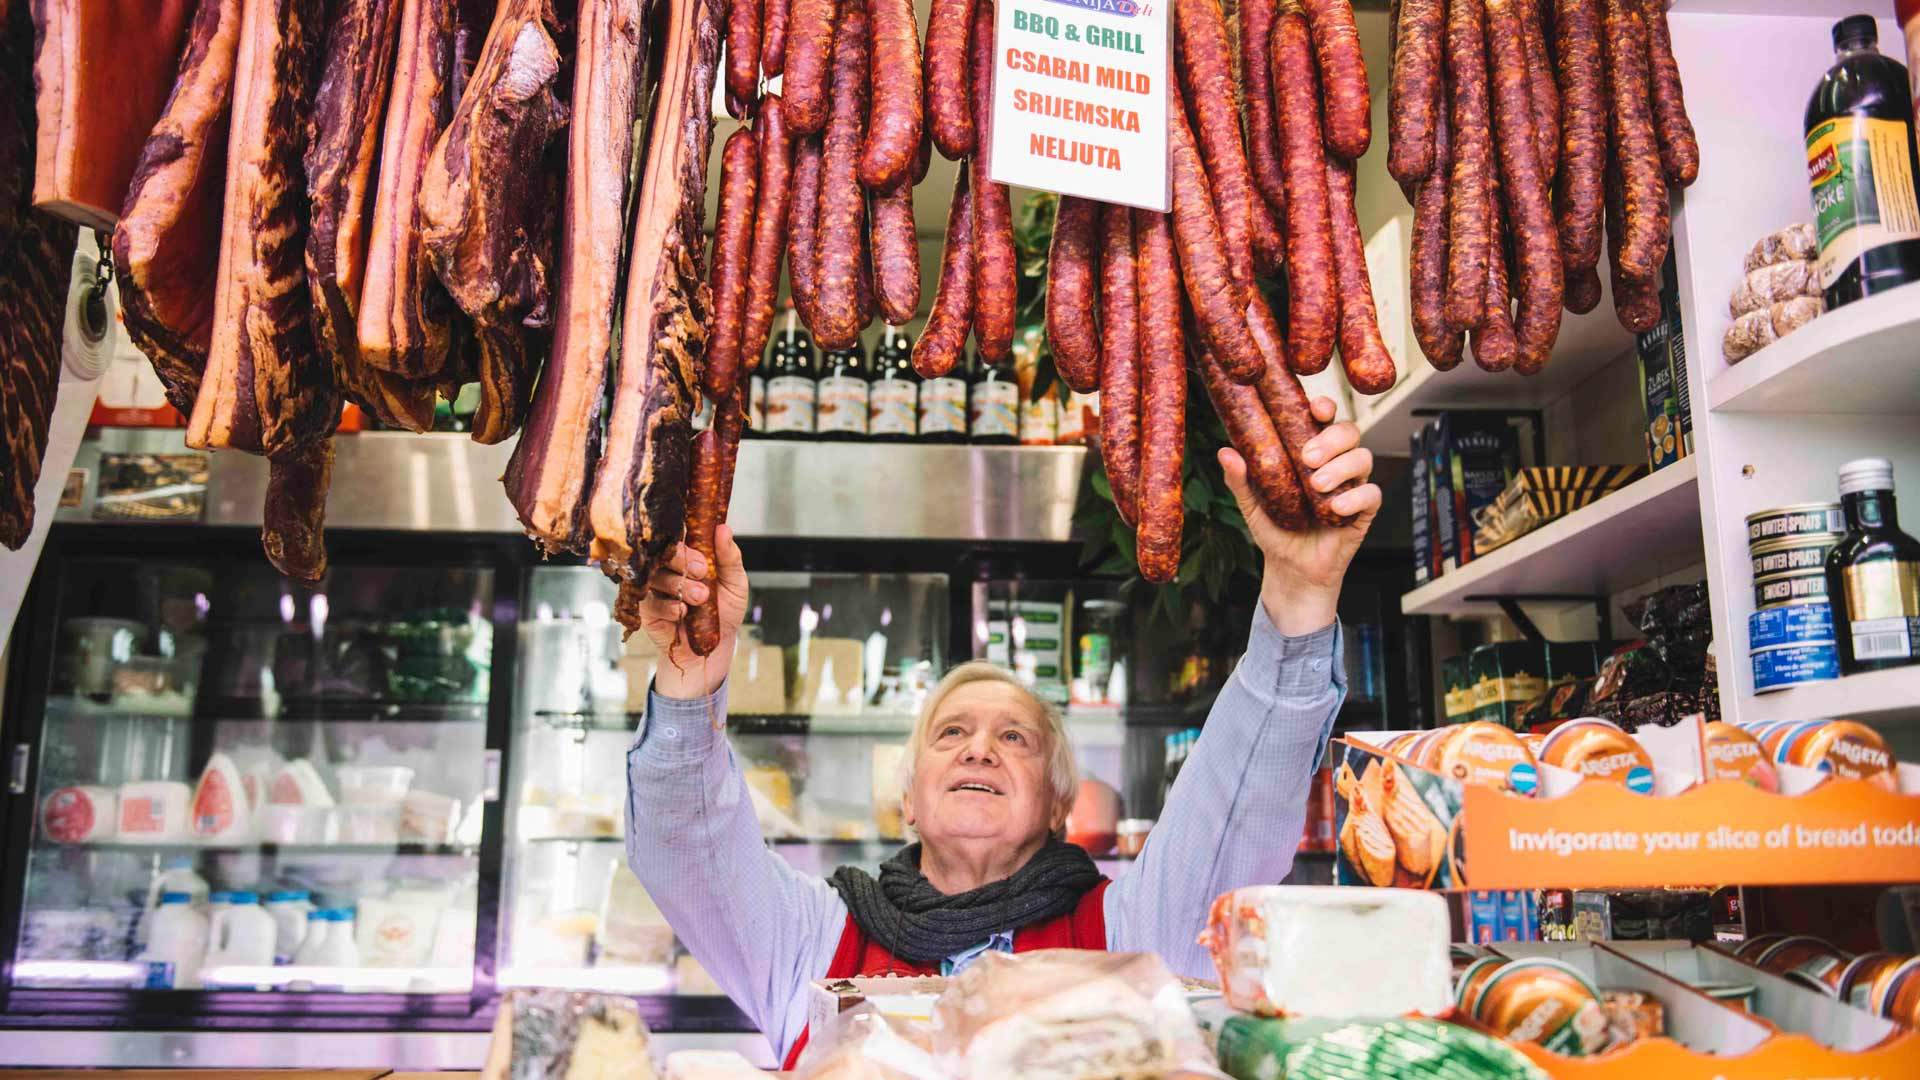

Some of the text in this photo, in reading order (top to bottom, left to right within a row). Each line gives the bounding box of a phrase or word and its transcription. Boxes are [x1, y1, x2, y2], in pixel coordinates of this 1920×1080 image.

[1013, 9, 1145, 54] BBQ & GRILL
[1006, 48, 1151, 95] CSABAI MILD
[1013, 88, 1141, 133] SRIJEMSKA
[1029, 133, 1122, 171] NELJUTA
[1761, 517, 1787, 536] WINTER
[1788, 514, 1821, 532] SPRATS
[1763, 553, 1788, 571] WINTER
[1788, 549, 1820, 567] SPRATS
[1791, 577, 1824, 596] WINTER
[1580, 752, 1639, 776] ARGETA
[1831, 738, 1890, 767] ARGETA
[1508, 827, 1639, 857] Invigorate
[1642, 831, 1700, 856] your
[1706, 825, 1760, 849] slice
[1765, 822, 1791, 848] of
[1795, 822, 1867, 848] bread
